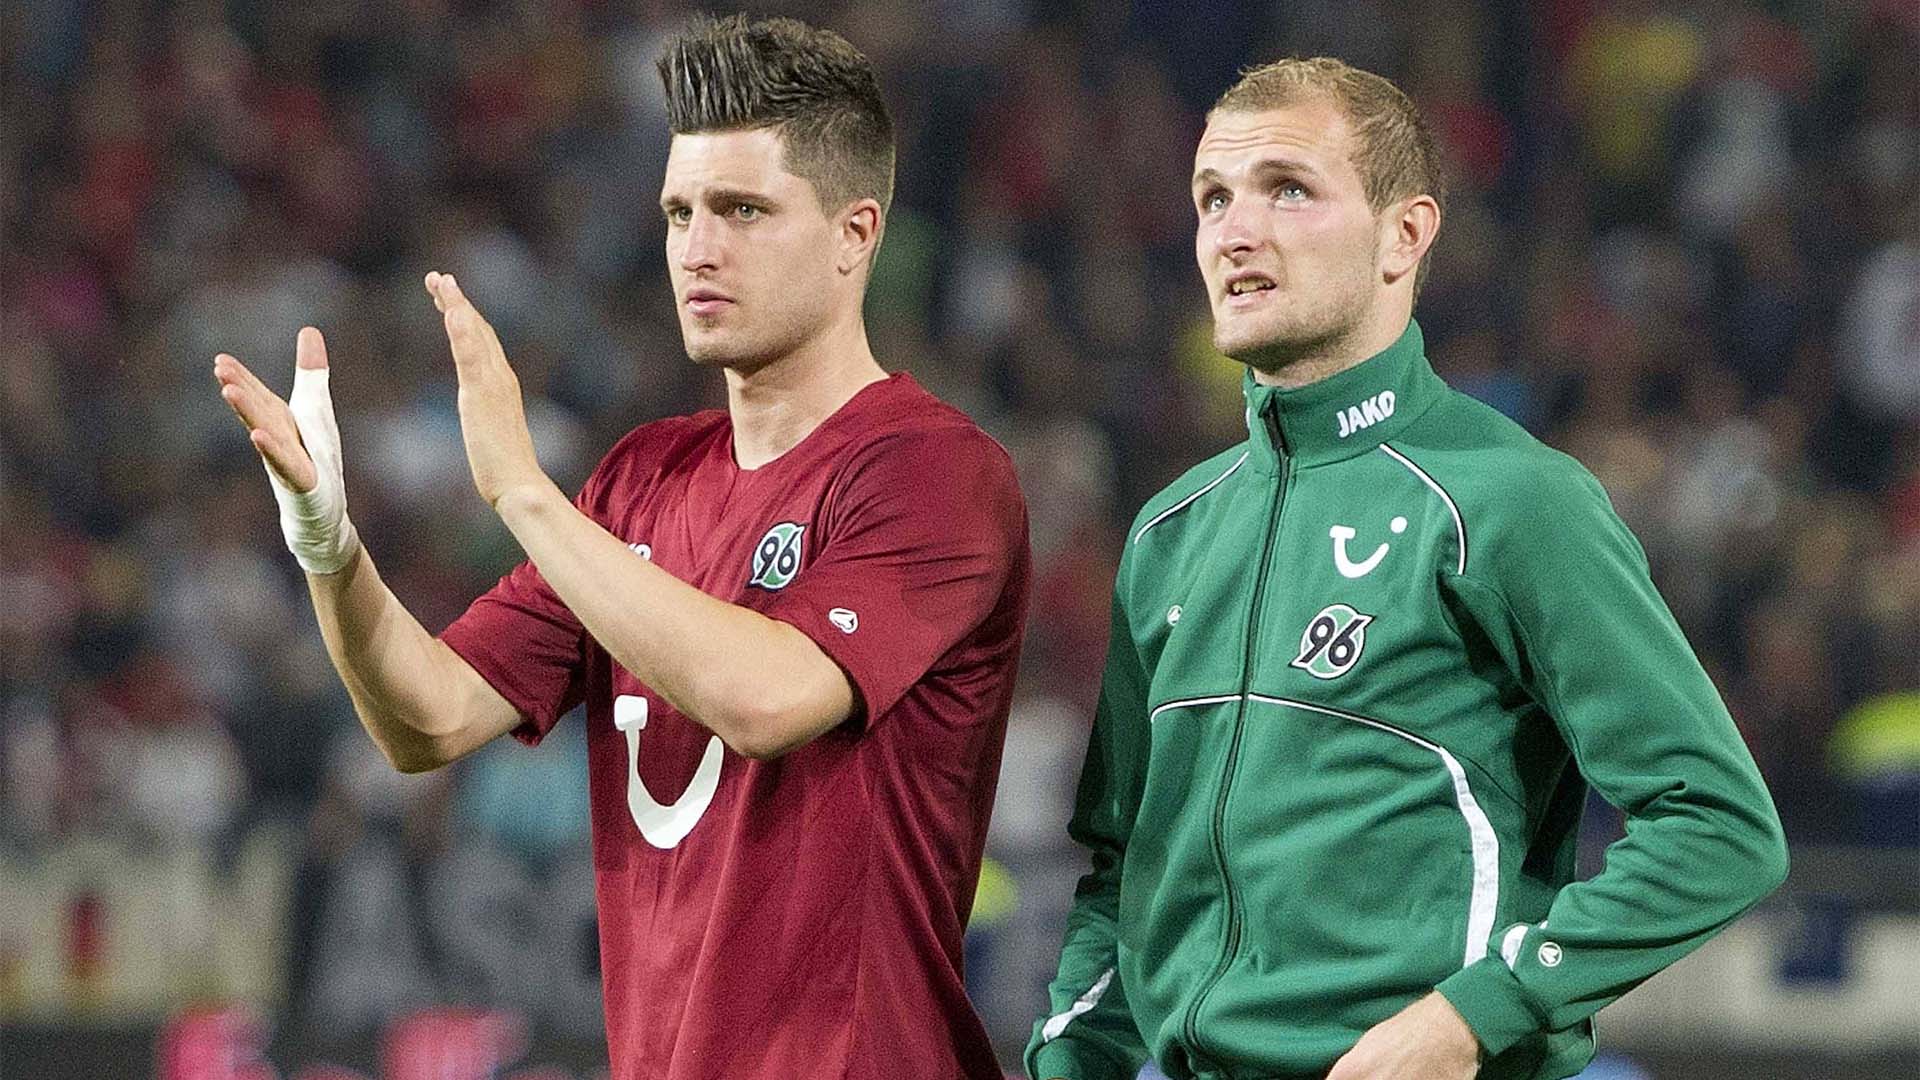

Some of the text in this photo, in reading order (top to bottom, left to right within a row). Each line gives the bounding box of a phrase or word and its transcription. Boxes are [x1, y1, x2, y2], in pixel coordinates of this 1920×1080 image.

[1336, 390, 1396, 438] JAKO
[755, 531, 800, 580] 96
[1299, 616, 1366, 667] 96
